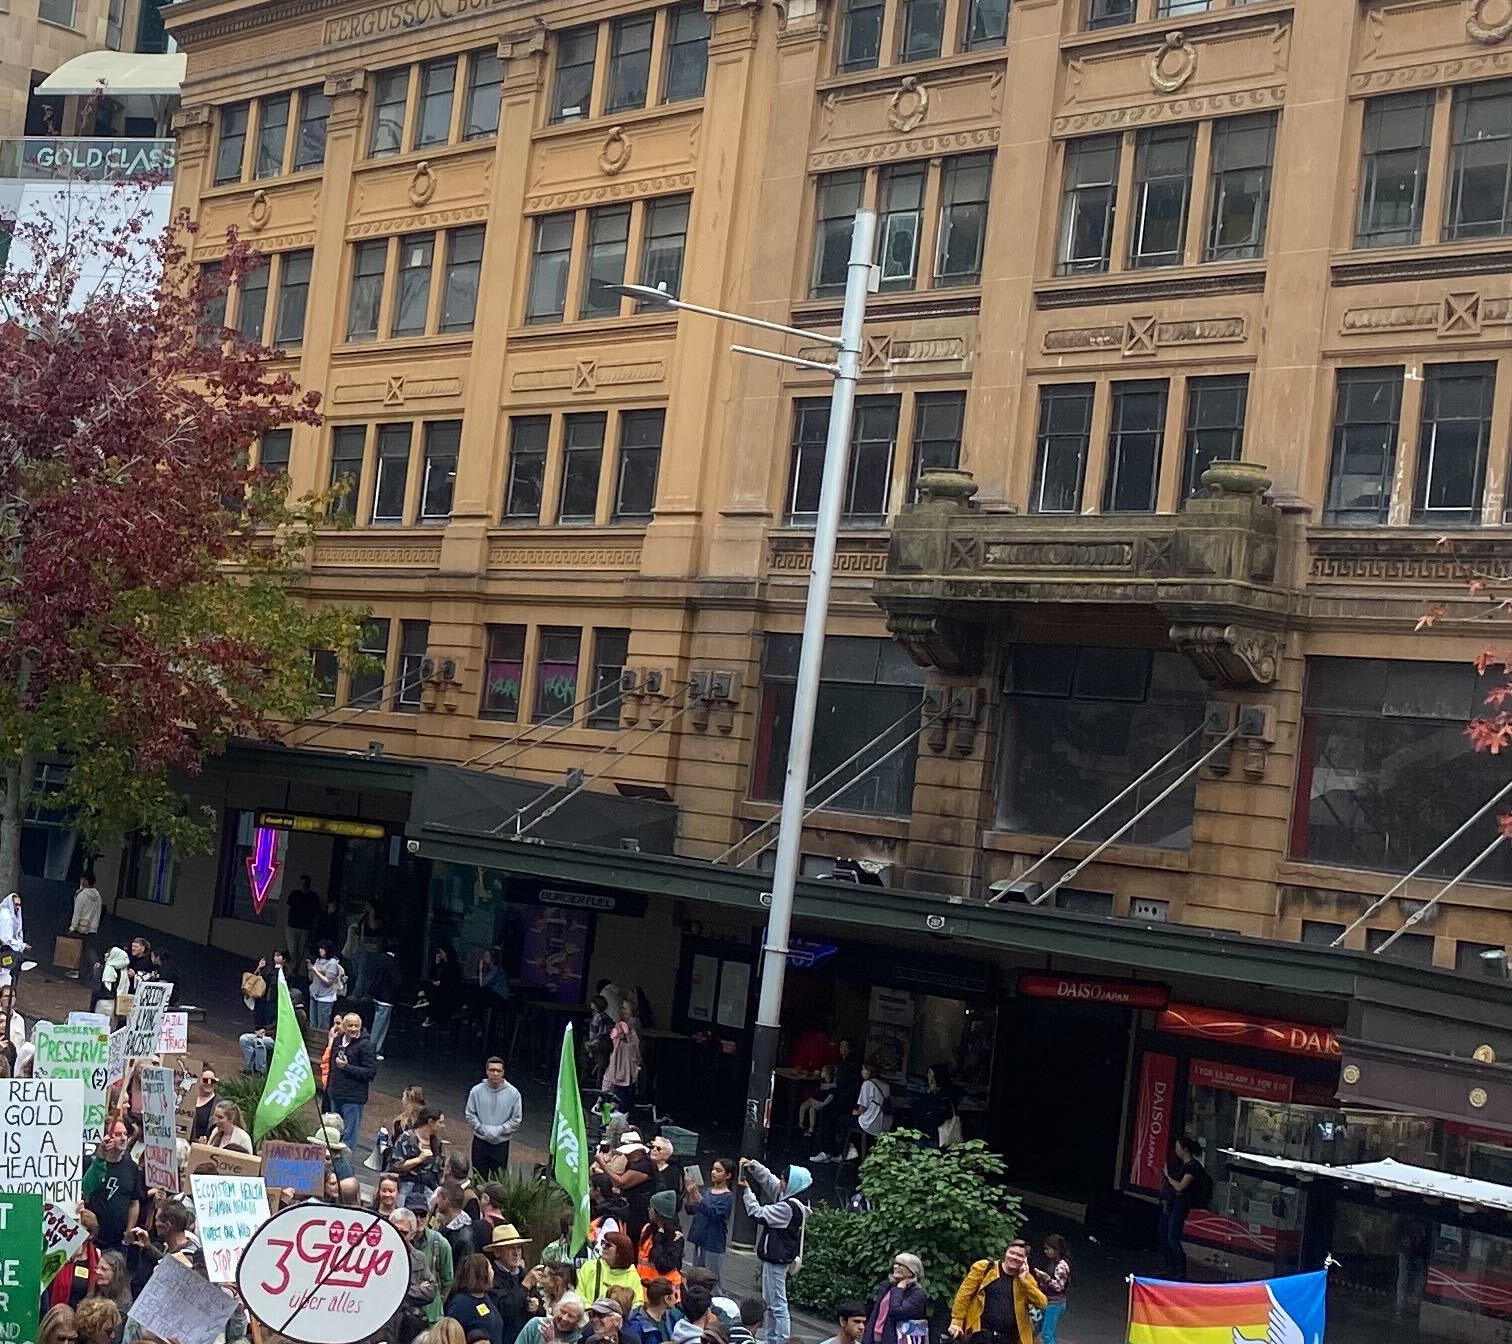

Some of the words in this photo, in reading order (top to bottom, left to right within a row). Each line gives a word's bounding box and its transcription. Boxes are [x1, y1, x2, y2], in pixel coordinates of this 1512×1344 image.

[37, 147, 103, 168] GOLD
[104, 147, 176, 176] CLASS
[1056, 981, 1102, 998] DAISO
[1101, 987, 1130, 1002] JAPAN
[37, 1032, 108, 1063] PRESERVE
[1288, 1028, 1343, 1056] DAIS
[9, 1080, 63, 1103] REAL
[4, 1104, 64, 1127] GOLD
[1151, 1080, 1168, 1136] DAISO
[3, 1131, 21, 1155] IS
[39, 1130, 58, 1154] A
[1146, 1135, 1157, 1168] JAPAN
[210, 1153, 243, 1174] Save
[261, 1238, 295, 1295] 3
[295, 1219, 394, 1289] Guys
[327, 1294, 362, 1314] alles
